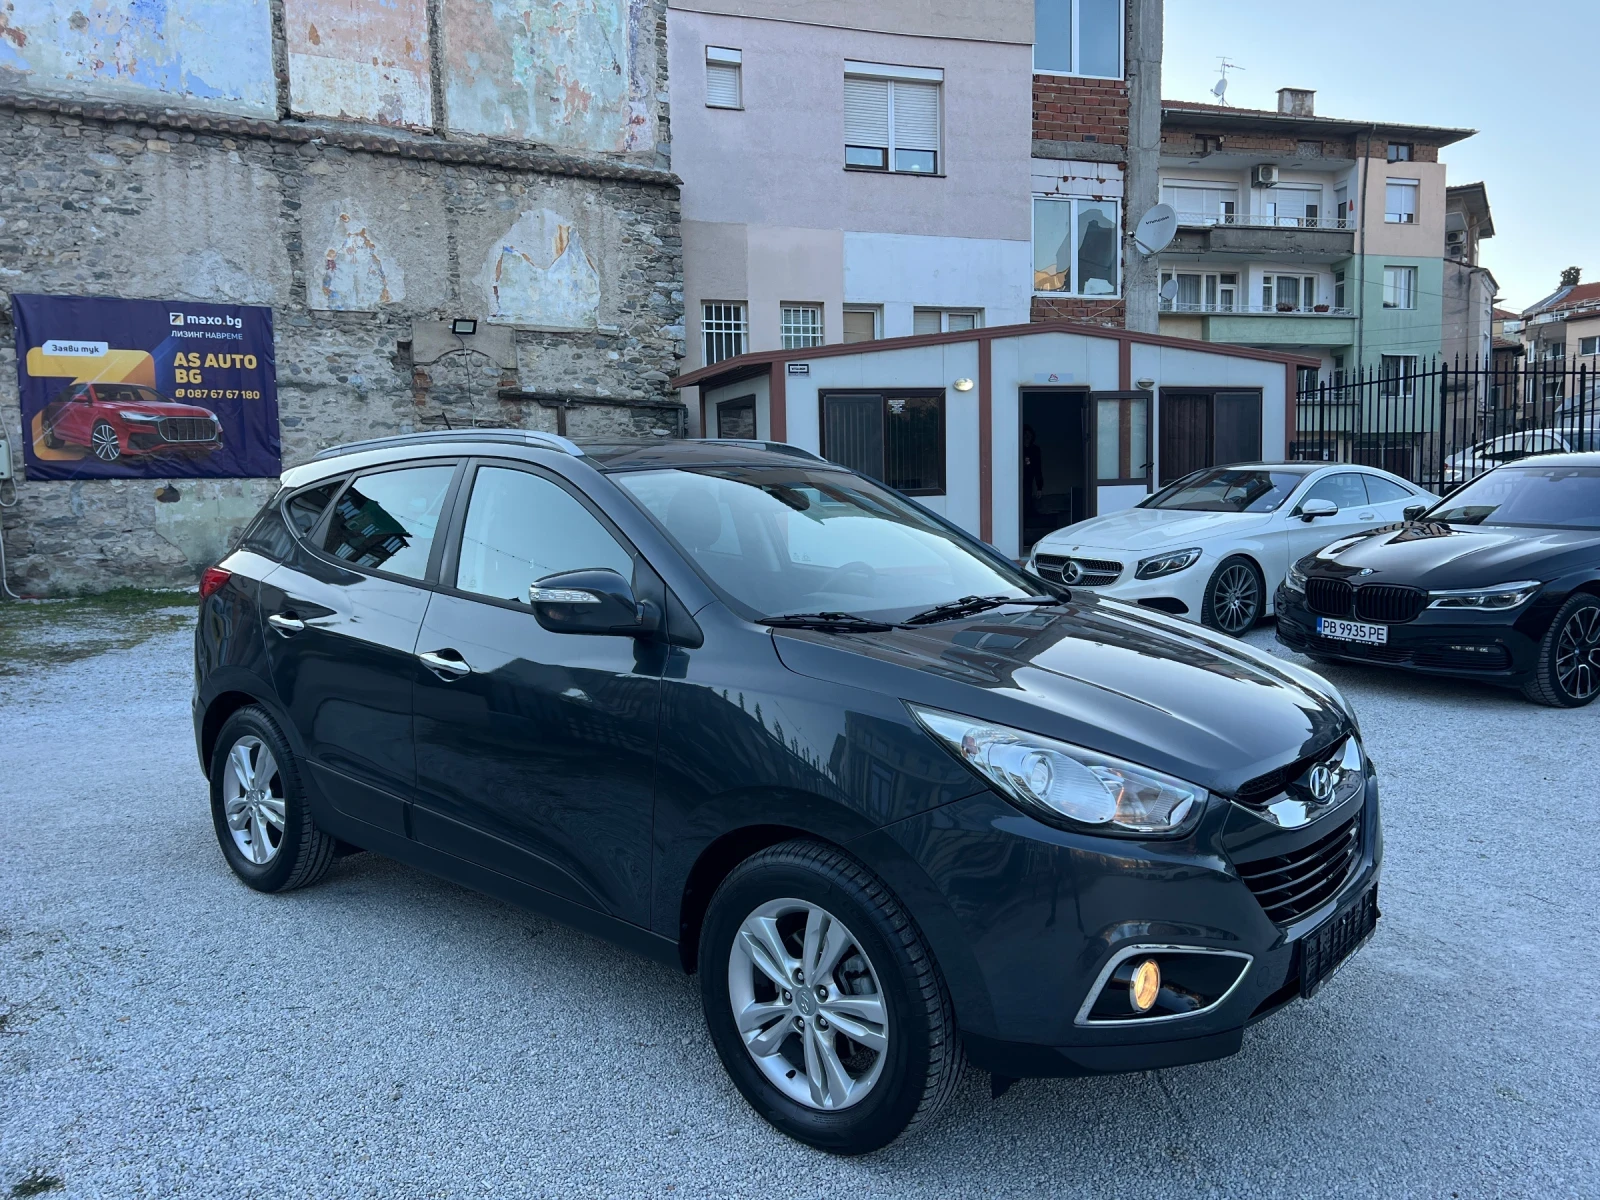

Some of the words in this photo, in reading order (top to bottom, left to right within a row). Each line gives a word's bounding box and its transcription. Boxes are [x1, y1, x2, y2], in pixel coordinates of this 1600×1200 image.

[186, 315, 242, 328] maxo.bg
[171, 330, 204, 338] ЛИЗИНГ
[205, 331, 243, 340] НАВРЕМЕ
[51, 344, 79, 352] Заяви
[80, 346, 100, 354] тук
[173, 352, 201, 367] AS
[204, 353, 257, 369] AUTO
[175, 368, 202, 384] BG
[187, 389, 208, 398] 087
[210, 390, 224, 399] 67
[225, 390, 239, 399] 67
[240, 390, 260, 399] 180
[1339, 622, 1366, 638] 9935
